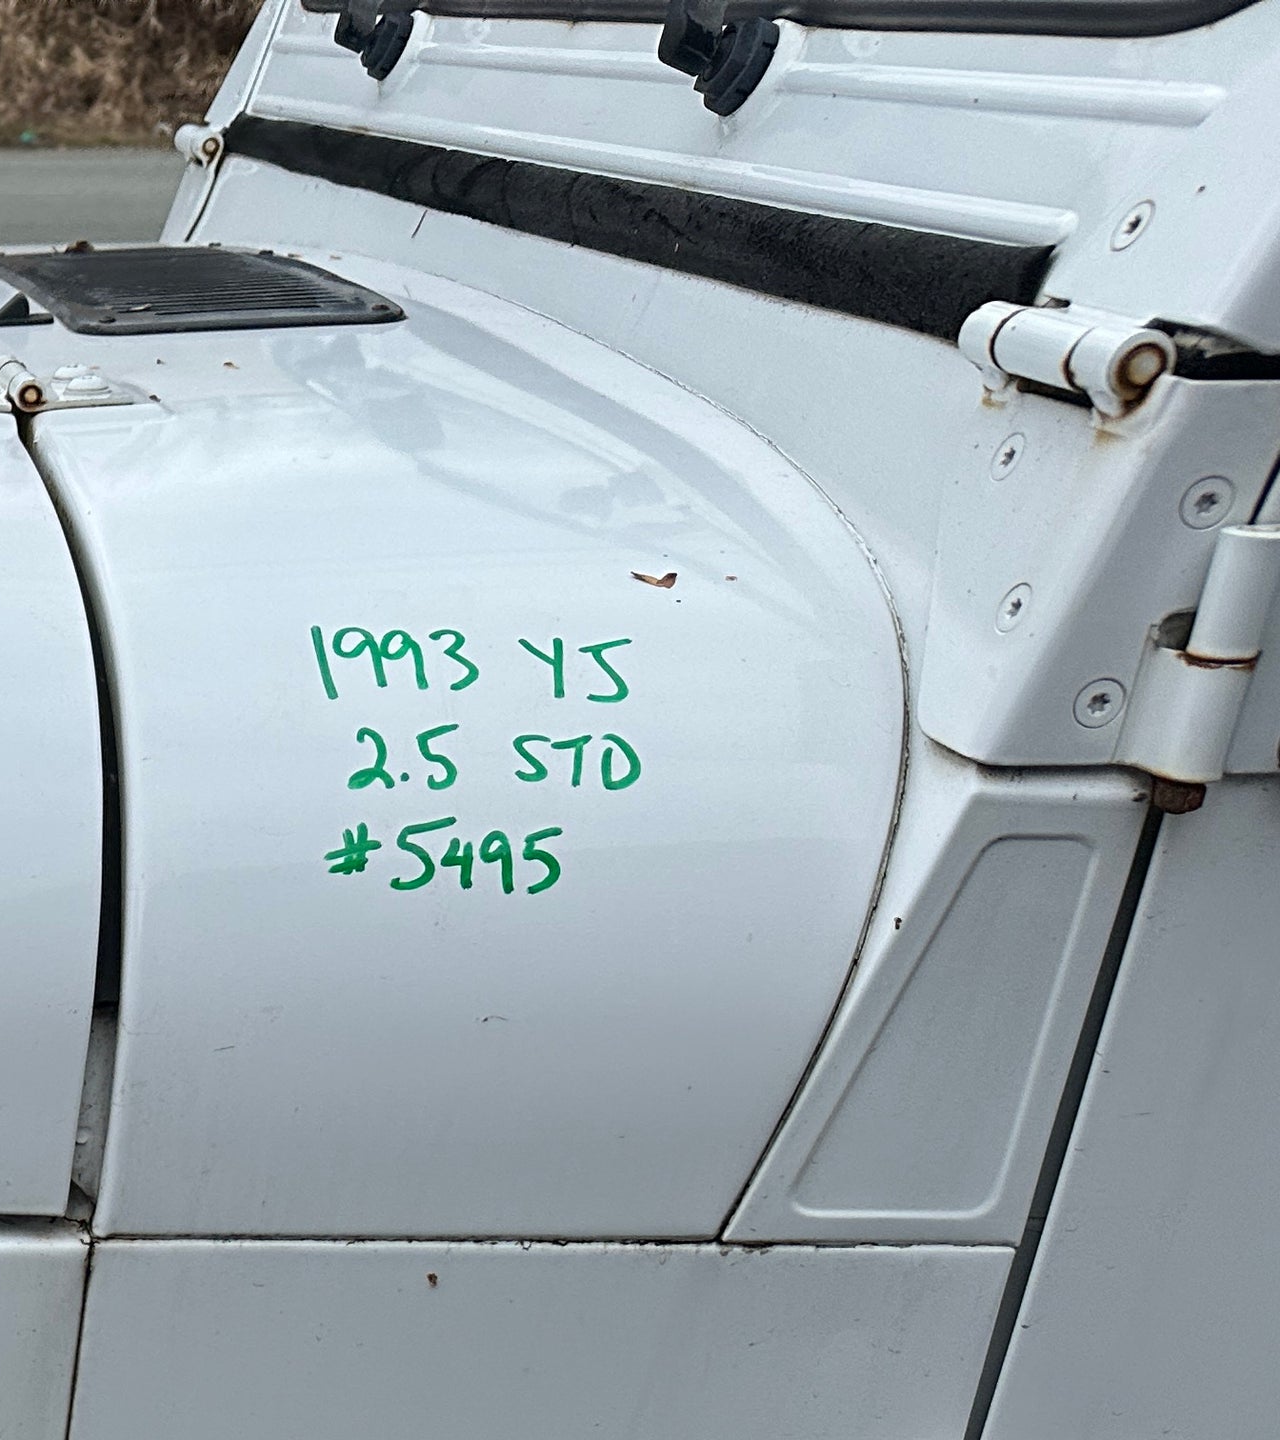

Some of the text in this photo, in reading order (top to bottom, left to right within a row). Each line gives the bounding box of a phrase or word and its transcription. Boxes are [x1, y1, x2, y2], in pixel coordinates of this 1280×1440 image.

[311, 625, 633, 703] 1993 YJ
[347, 723, 642, 790] 2.5 STD
[324, 816, 563, 895] #5495
